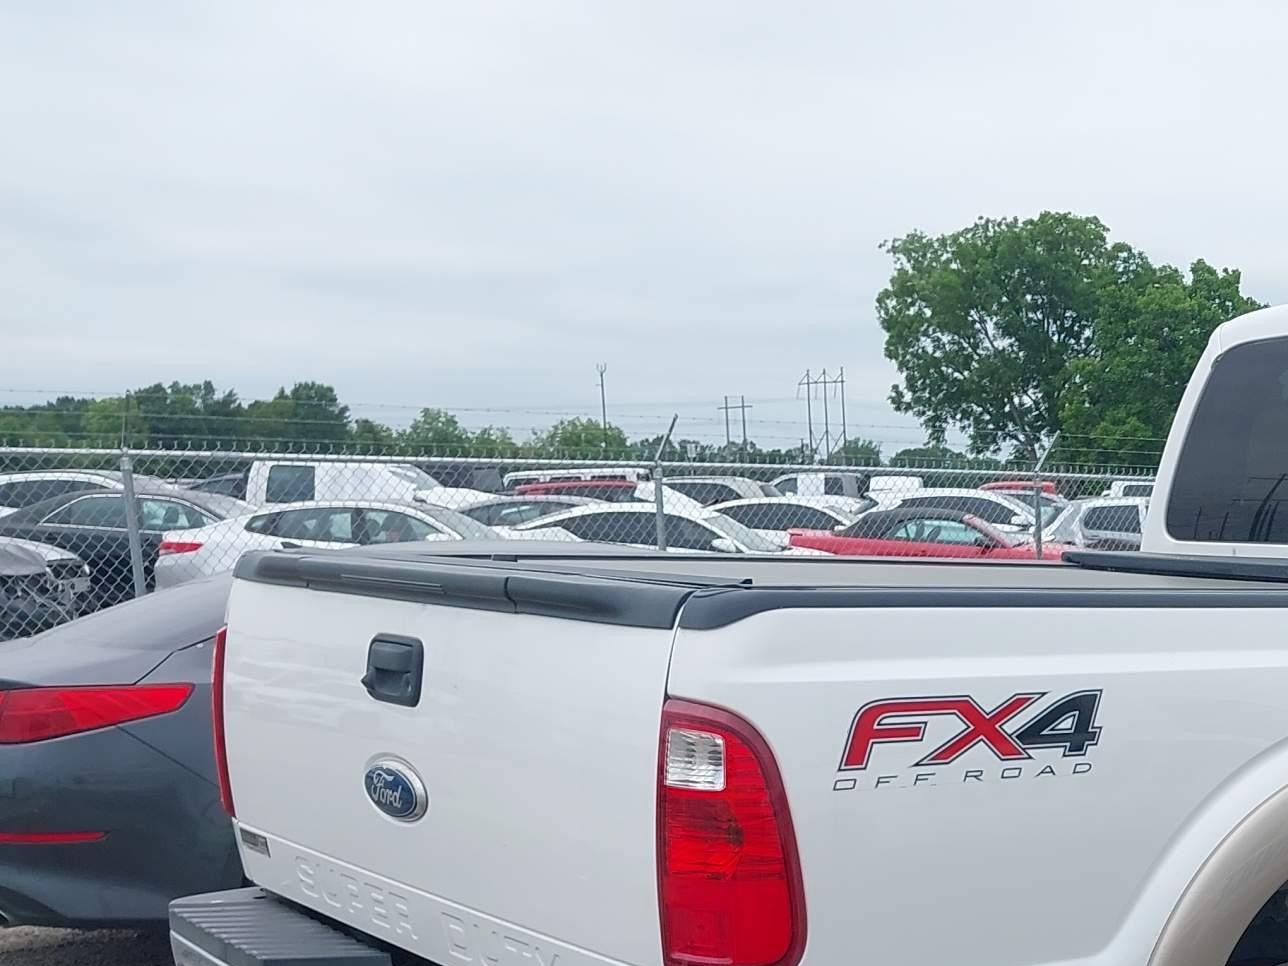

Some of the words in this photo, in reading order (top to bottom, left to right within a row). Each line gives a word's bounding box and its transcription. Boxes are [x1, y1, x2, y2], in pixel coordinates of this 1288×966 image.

[837, 688, 1104, 772] FX4
[371, 769, 403, 809] Ford
[832, 773, 937, 792] OFF
[963, 762, 1093, 783] ROAD
[295, 855, 419, 940] SUPER
